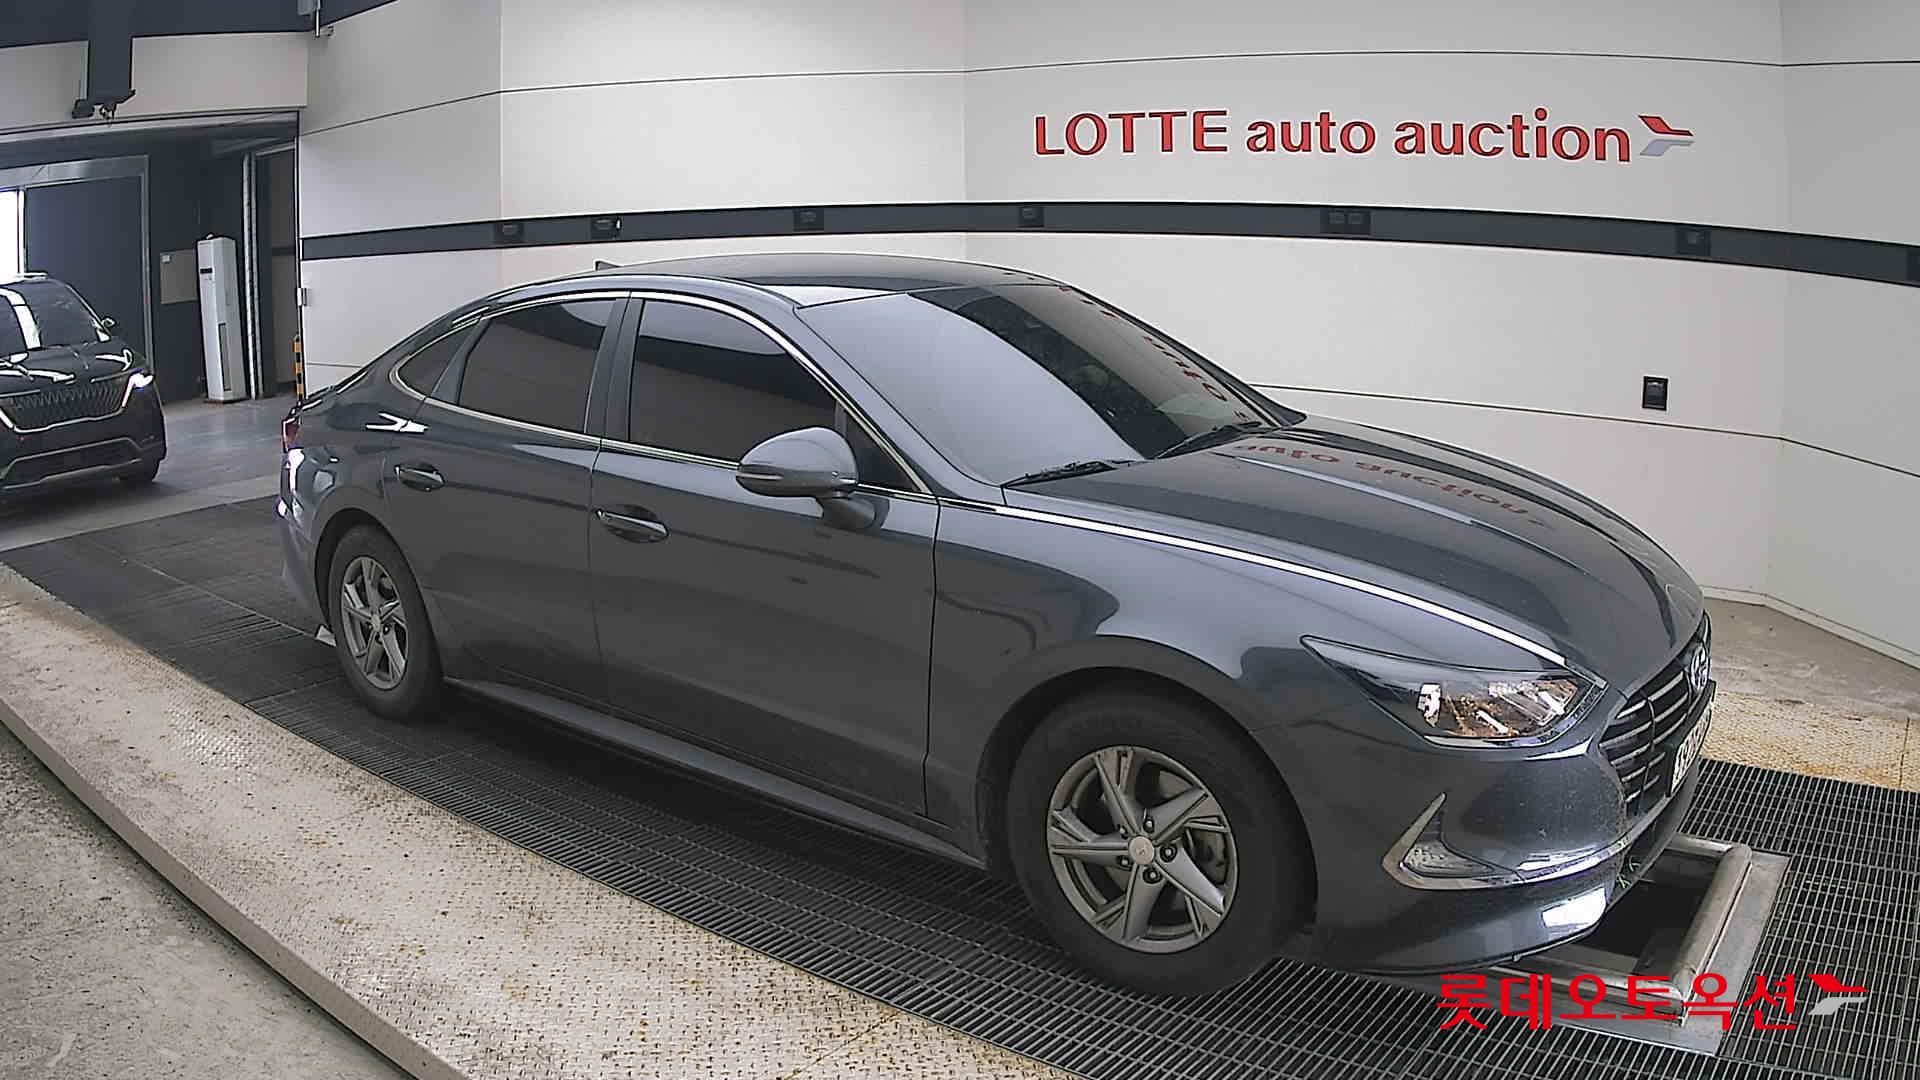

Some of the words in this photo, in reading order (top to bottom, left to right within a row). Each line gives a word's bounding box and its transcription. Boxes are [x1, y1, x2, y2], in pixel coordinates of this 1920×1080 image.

[1035, 109, 1228, 156] LOTTE
[1246, 111, 1376, 155] auto
[1394, 107, 1632, 163] auction
